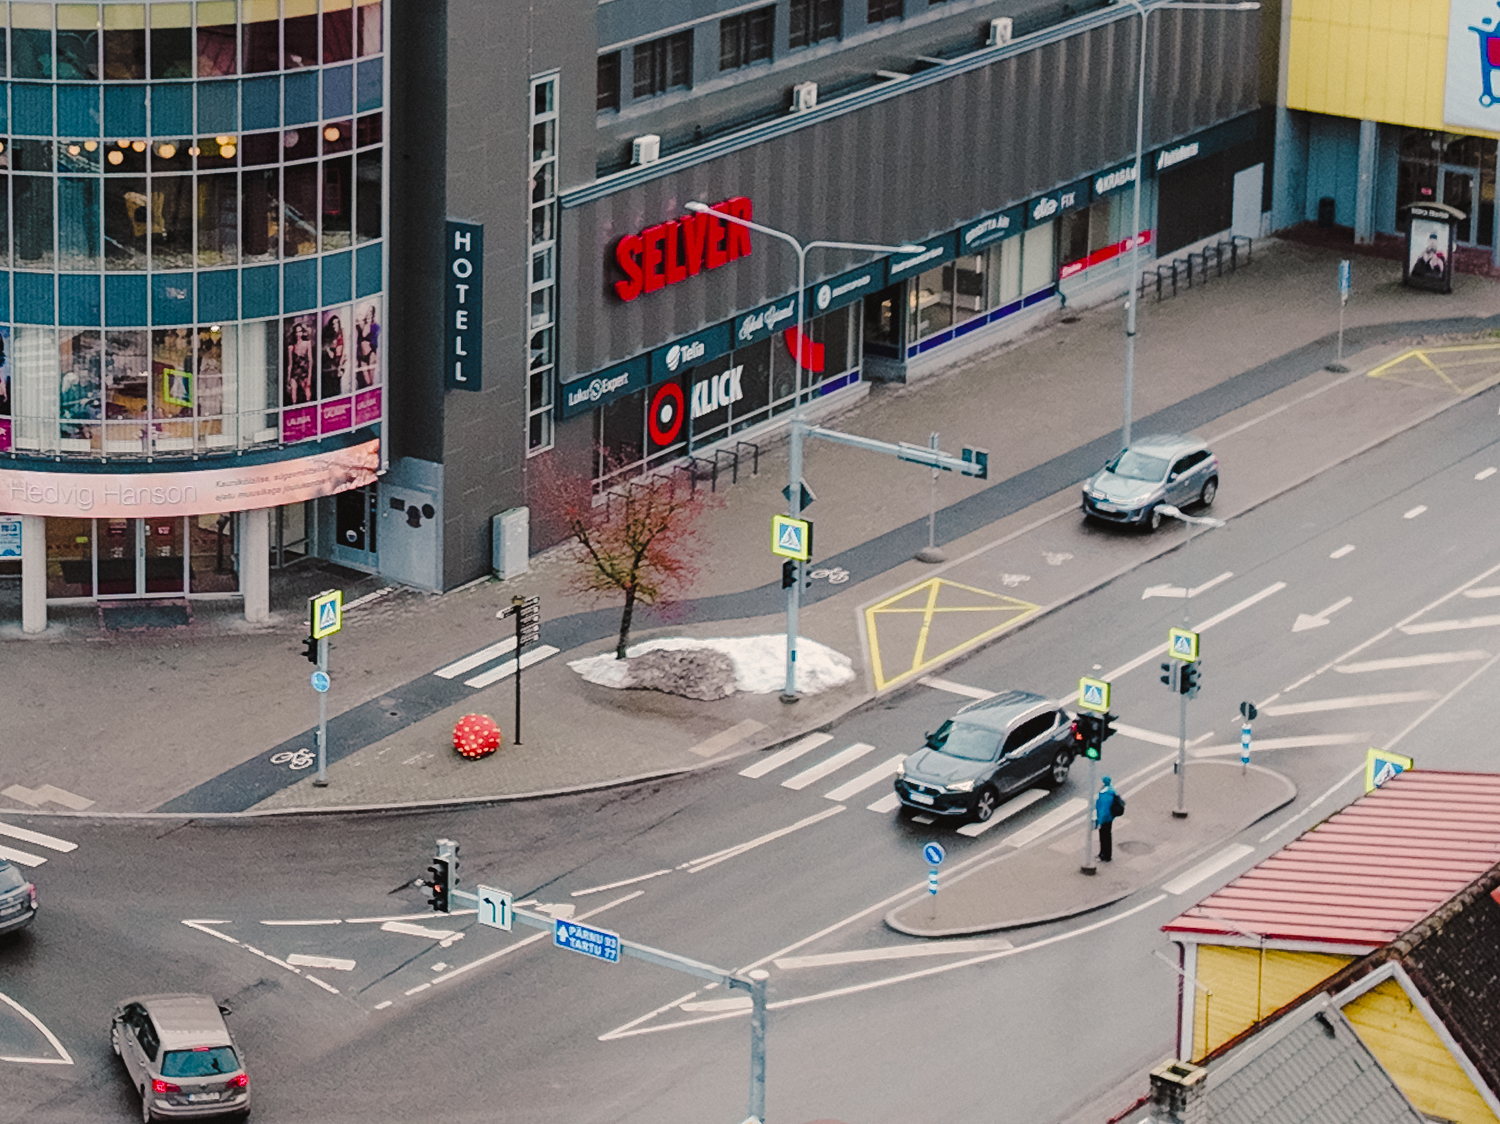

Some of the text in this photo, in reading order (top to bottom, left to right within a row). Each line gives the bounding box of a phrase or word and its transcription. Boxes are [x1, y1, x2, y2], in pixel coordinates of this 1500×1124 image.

[614, 196, 753, 302] SELVER
[452, 230, 473, 382] HOTELL
[680, 341, 705, 364] Telia
[690, 365, 744, 421] KLICK
[10, 479, 197, 511] Hedvig Hanson
[568, 926, 603, 944] PÄRNU
[569, 937, 602, 955] TARTU
